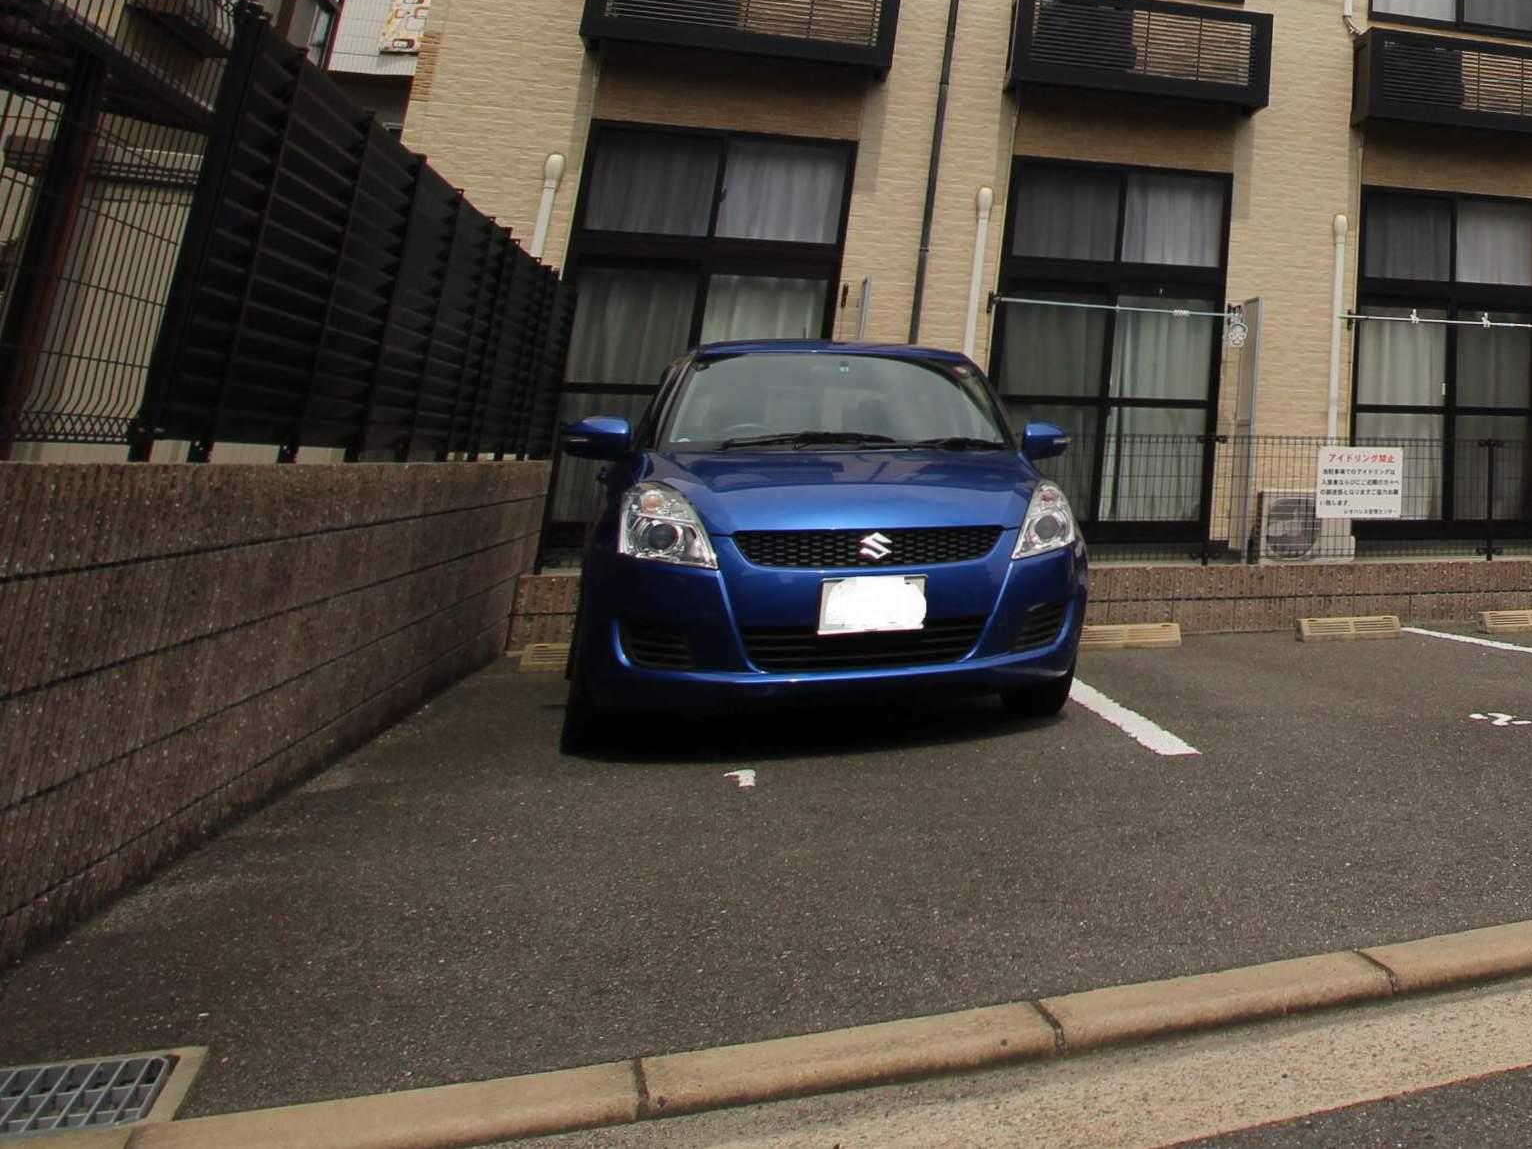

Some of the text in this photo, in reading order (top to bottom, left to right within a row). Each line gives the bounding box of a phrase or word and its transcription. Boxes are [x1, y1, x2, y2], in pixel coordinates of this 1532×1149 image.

[1328, 453, 1395, 463] アイドリング禁止
